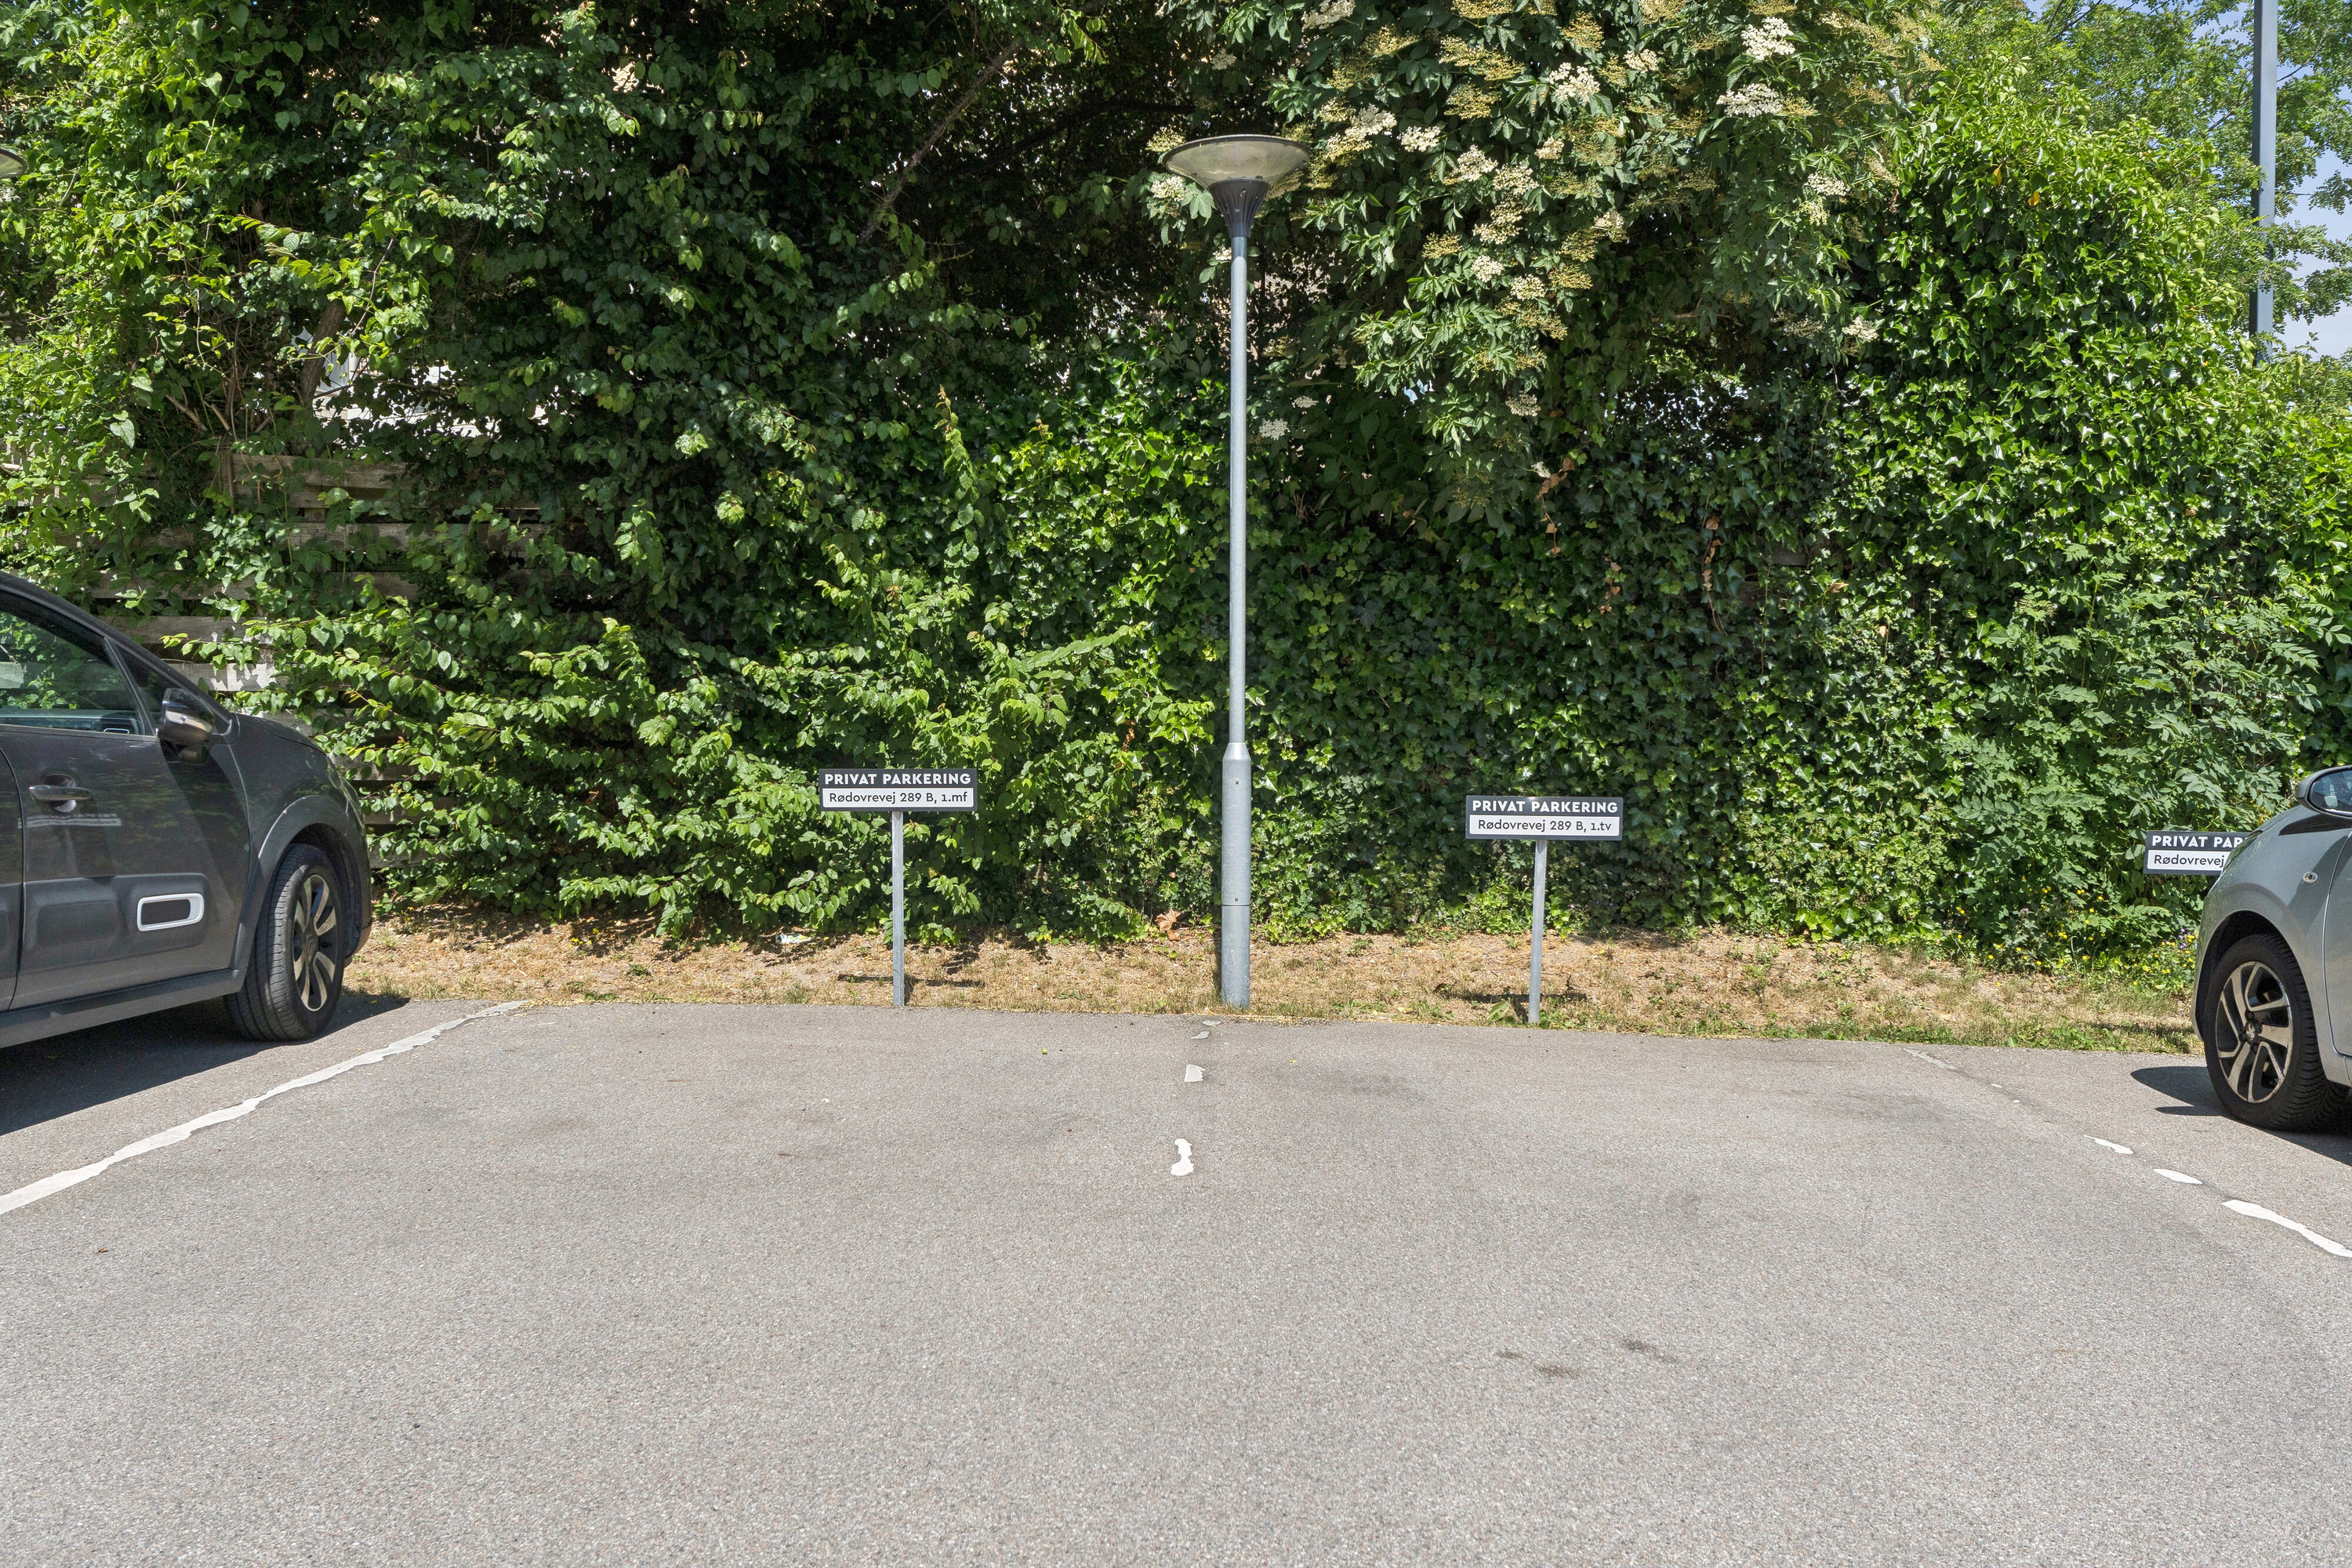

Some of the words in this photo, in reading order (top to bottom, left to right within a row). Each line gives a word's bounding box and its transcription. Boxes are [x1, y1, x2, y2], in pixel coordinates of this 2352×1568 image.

[825, 773, 877, 785] PRIVAT
[883, 773, 971, 785] PARKERING
[829, 792, 896, 804] Rødovrevej
[900, 793, 922, 802] 289
[926, 793, 937, 804] B,
[941, 792, 968, 802] 1.mf
[1472, 800, 1526, 812] PRIVAT
[1531, 800, 1618, 813] PARKERING
[1478, 819, 1545, 833] Rødovrevej
[1550, 821, 1571, 830] 289
[1576, 822, 1586, 833] B,
[1591, 822, 1612, 831] 1.tv
[2152, 835, 2208, 848] PRIVAT
[2213, 837, 2248, 848] PAR
[2154, 854, 2225, 867] Rødovrevej
